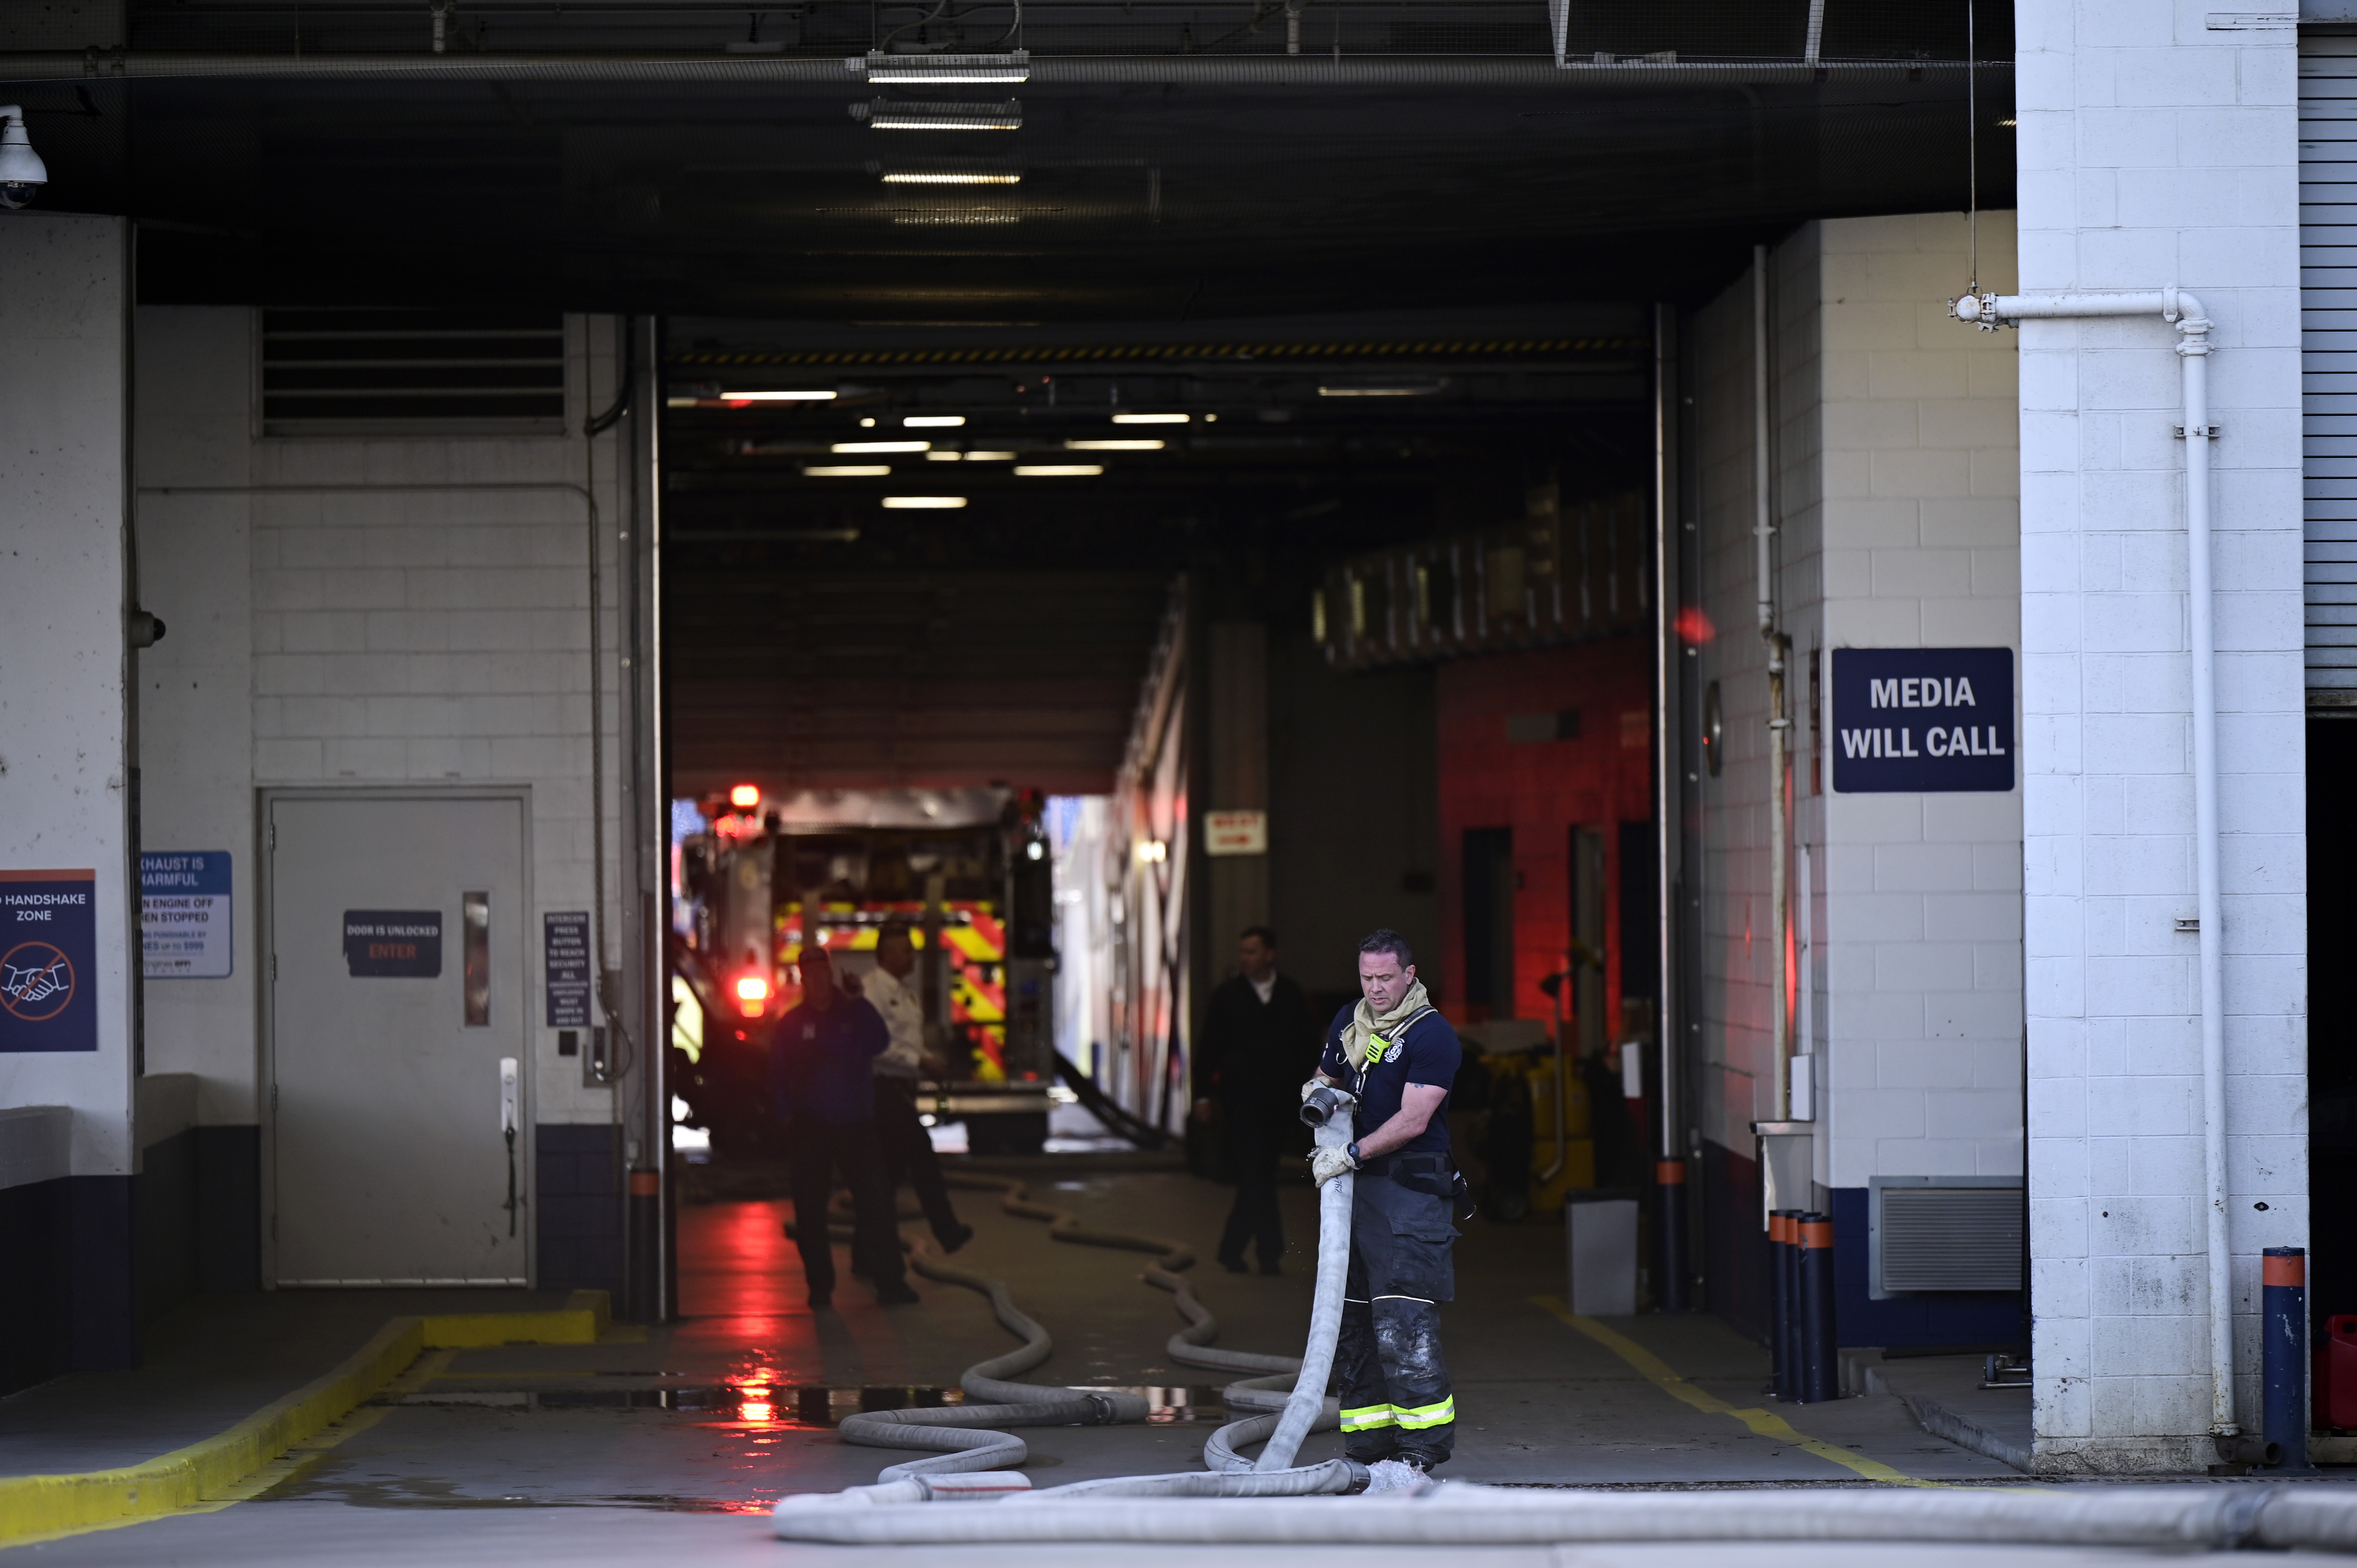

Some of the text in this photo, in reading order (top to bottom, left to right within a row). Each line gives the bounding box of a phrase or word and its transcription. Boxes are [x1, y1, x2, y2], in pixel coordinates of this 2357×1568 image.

[1871, 677, 1976, 708] MEDIA
[1841, 726, 2005, 758] WILL CALL
[192, 856, 205, 871] IS
[5, 894, 85, 905] HANDSHAKE
[153, 899, 191, 909] ENGINE
[193, 898, 213, 909] OFF
[17, 910, 52, 921] ZONE
[161, 911, 209, 923] STOPPED
[347, 925, 438, 937] DOOR IS UNLOCKED
[554, 926, 579, 935] PRESS
[552, 937, 581, 946] BUTTON
[369, 943, 416, 959] ENTER
[549, 948, 585, 958] TO REACH
[549, 959, 585, 969] SECURITY
[561, 970, 576, 980] ALL
